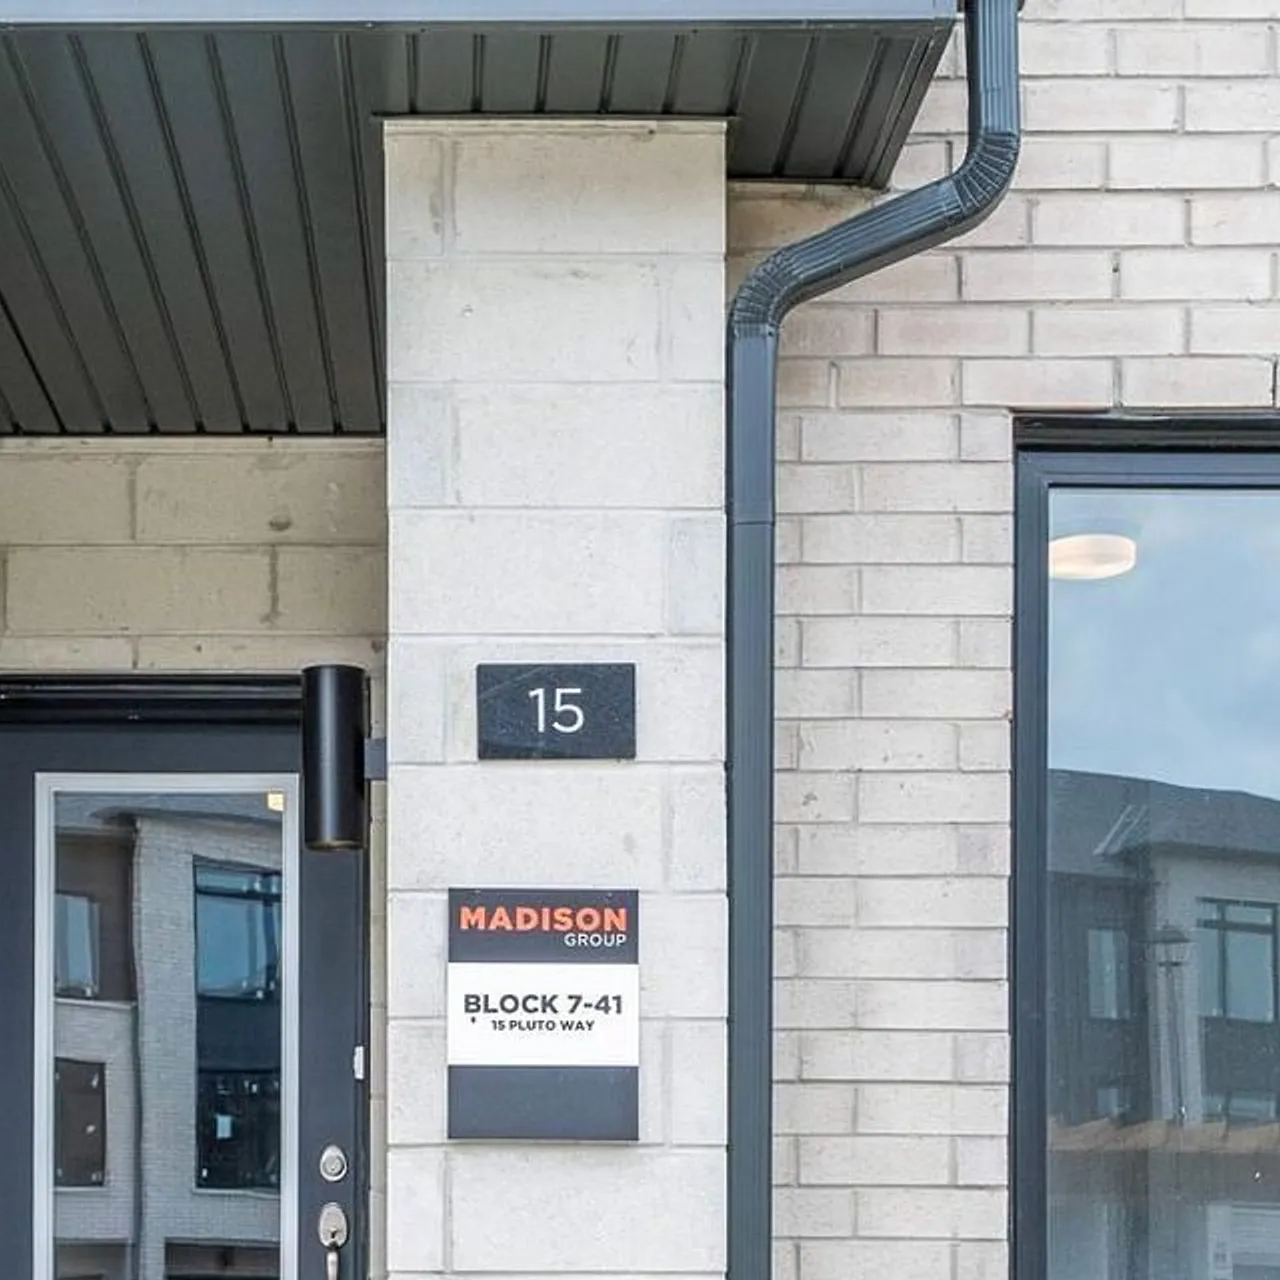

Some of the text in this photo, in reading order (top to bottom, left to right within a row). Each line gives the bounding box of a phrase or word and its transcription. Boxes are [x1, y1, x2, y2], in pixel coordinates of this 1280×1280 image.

[528, 687, 585, 734] 15
[459, 905, 628, 932] MADISON
[563, 933, 628, 948] GROUP
[463, 993, 623, 1015] BLOCK 7-41
[491, 1019, 595, 1031] 15 PLUTO WAY
